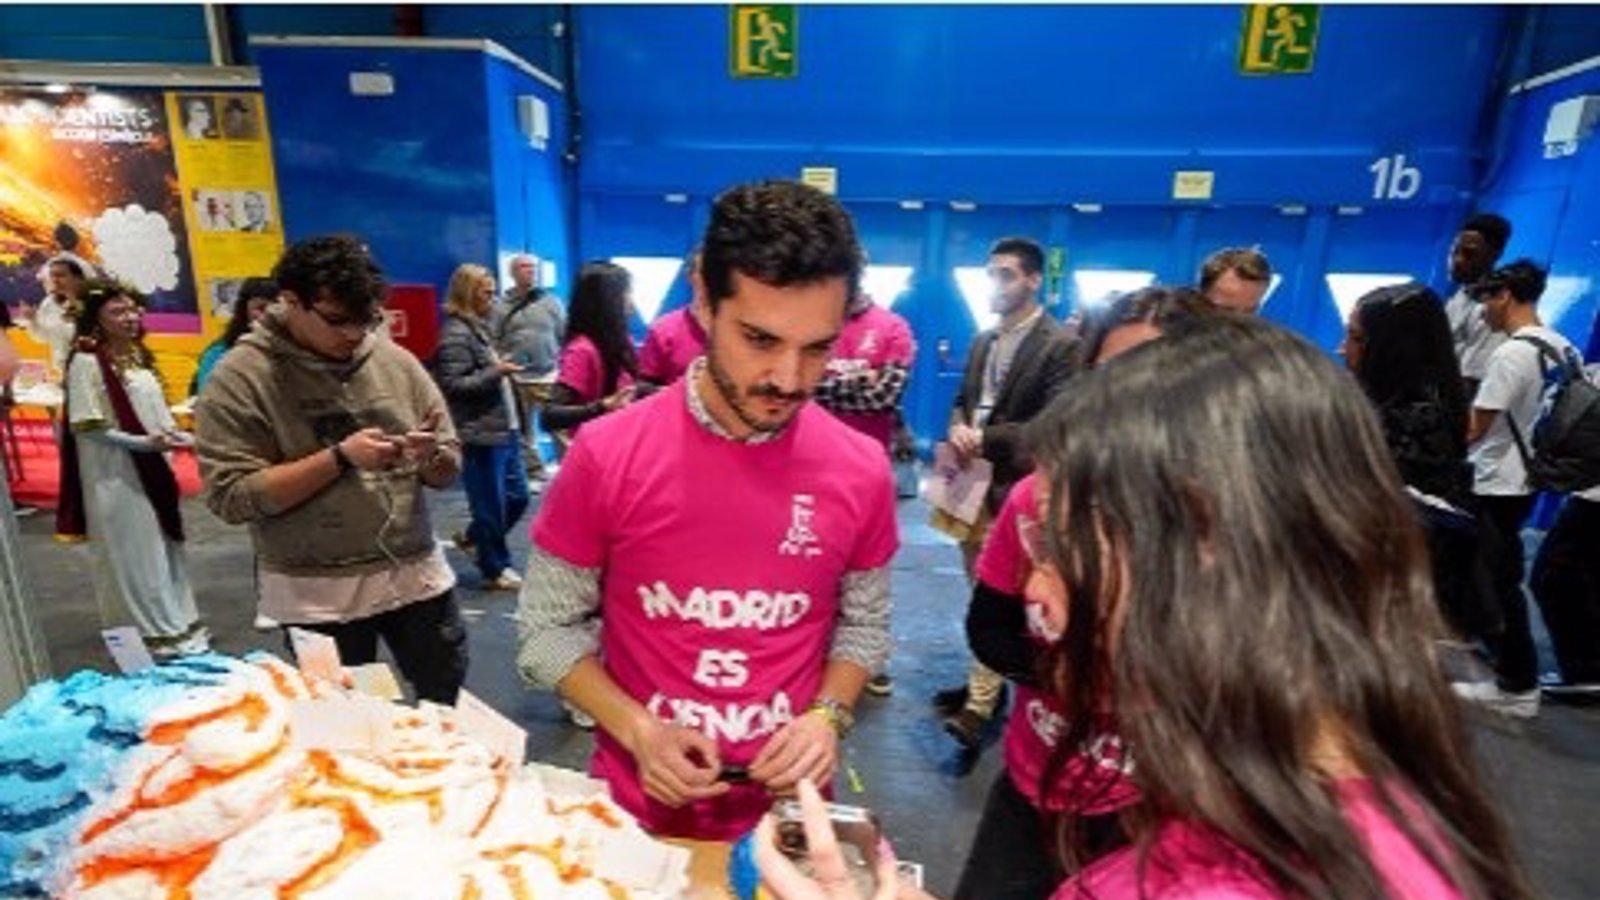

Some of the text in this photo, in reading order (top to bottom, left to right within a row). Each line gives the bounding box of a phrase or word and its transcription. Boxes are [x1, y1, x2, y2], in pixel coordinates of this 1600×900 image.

[1369, 154, 1421, 199] 1b
[637, 580, 812, 630] MADRID
[692, 648, 750, 687] ES
